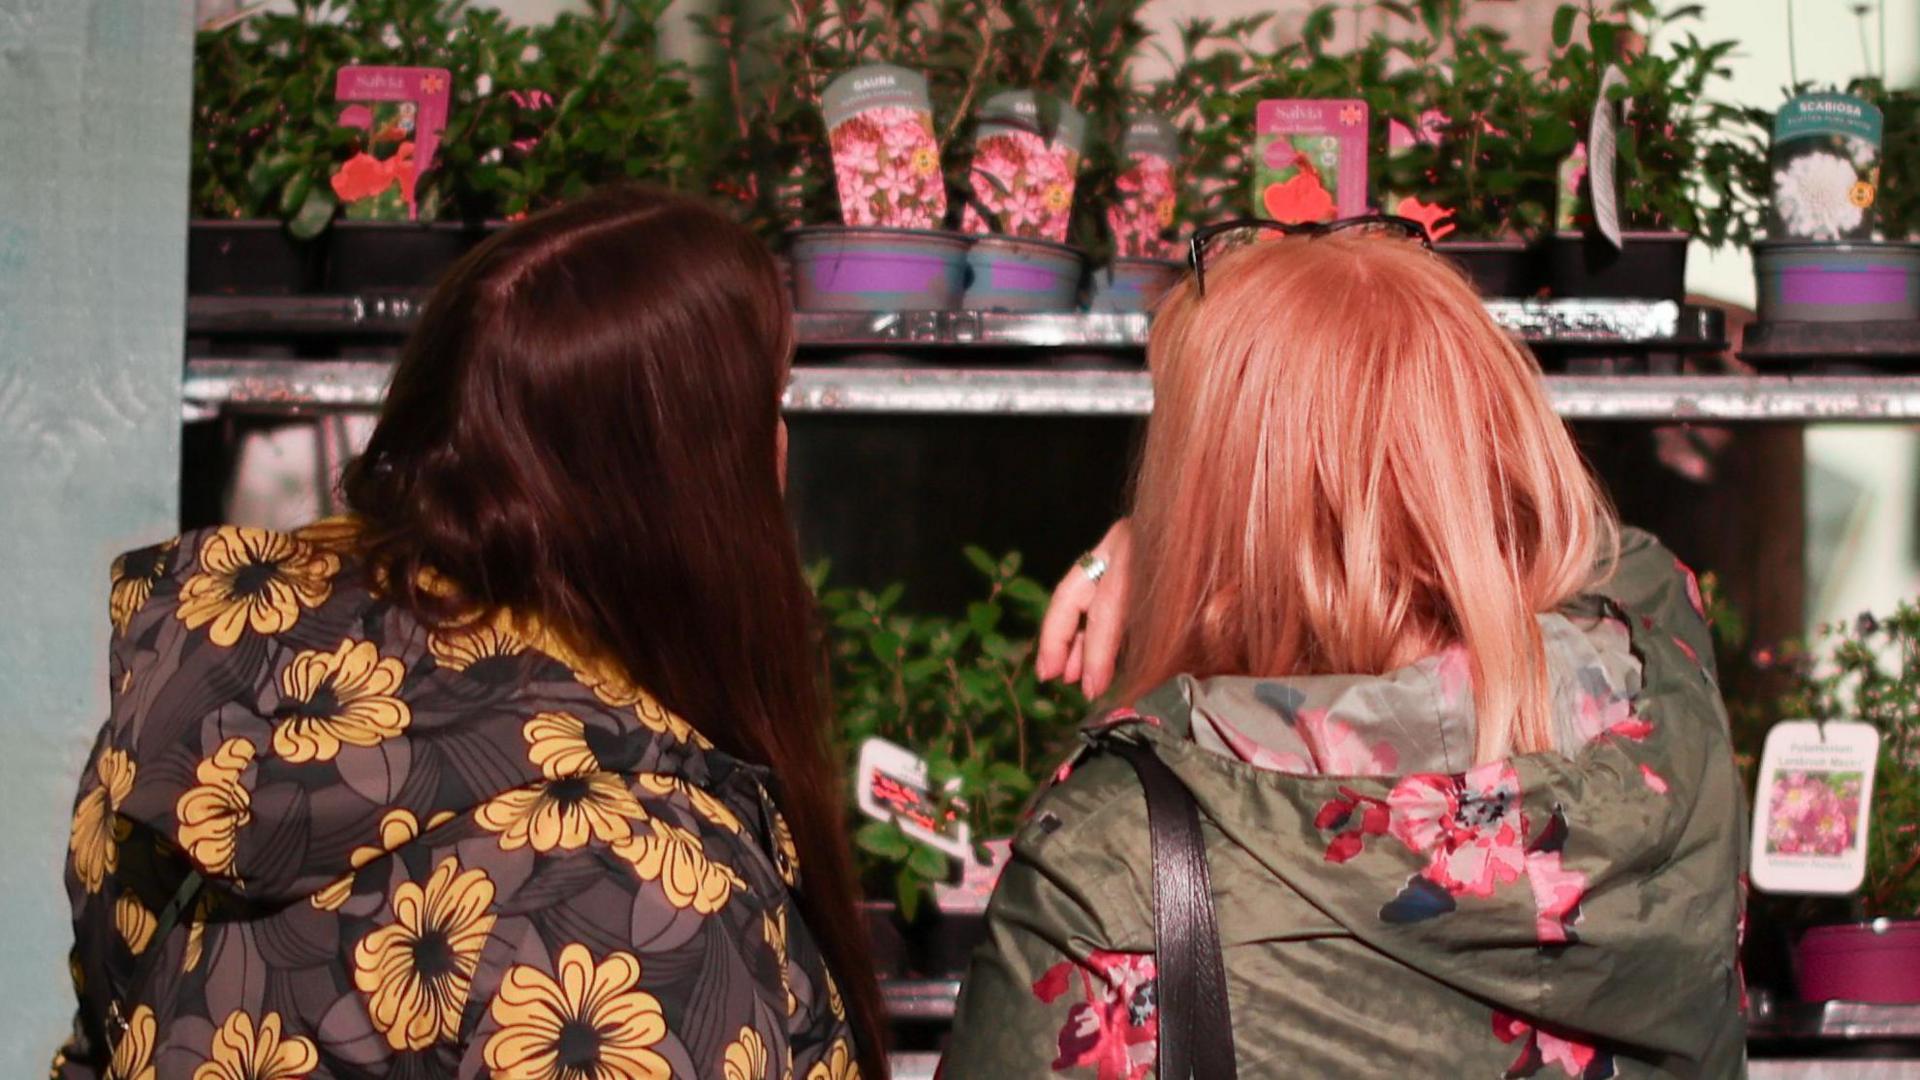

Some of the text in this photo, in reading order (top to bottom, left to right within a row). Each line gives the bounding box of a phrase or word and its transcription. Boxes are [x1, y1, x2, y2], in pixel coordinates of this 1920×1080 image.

[853, 75, 896, 91] GAURA
[1275, 104, 1323, 119] Salvia
[1799, 101, 1862, 117] SCABIOSA
